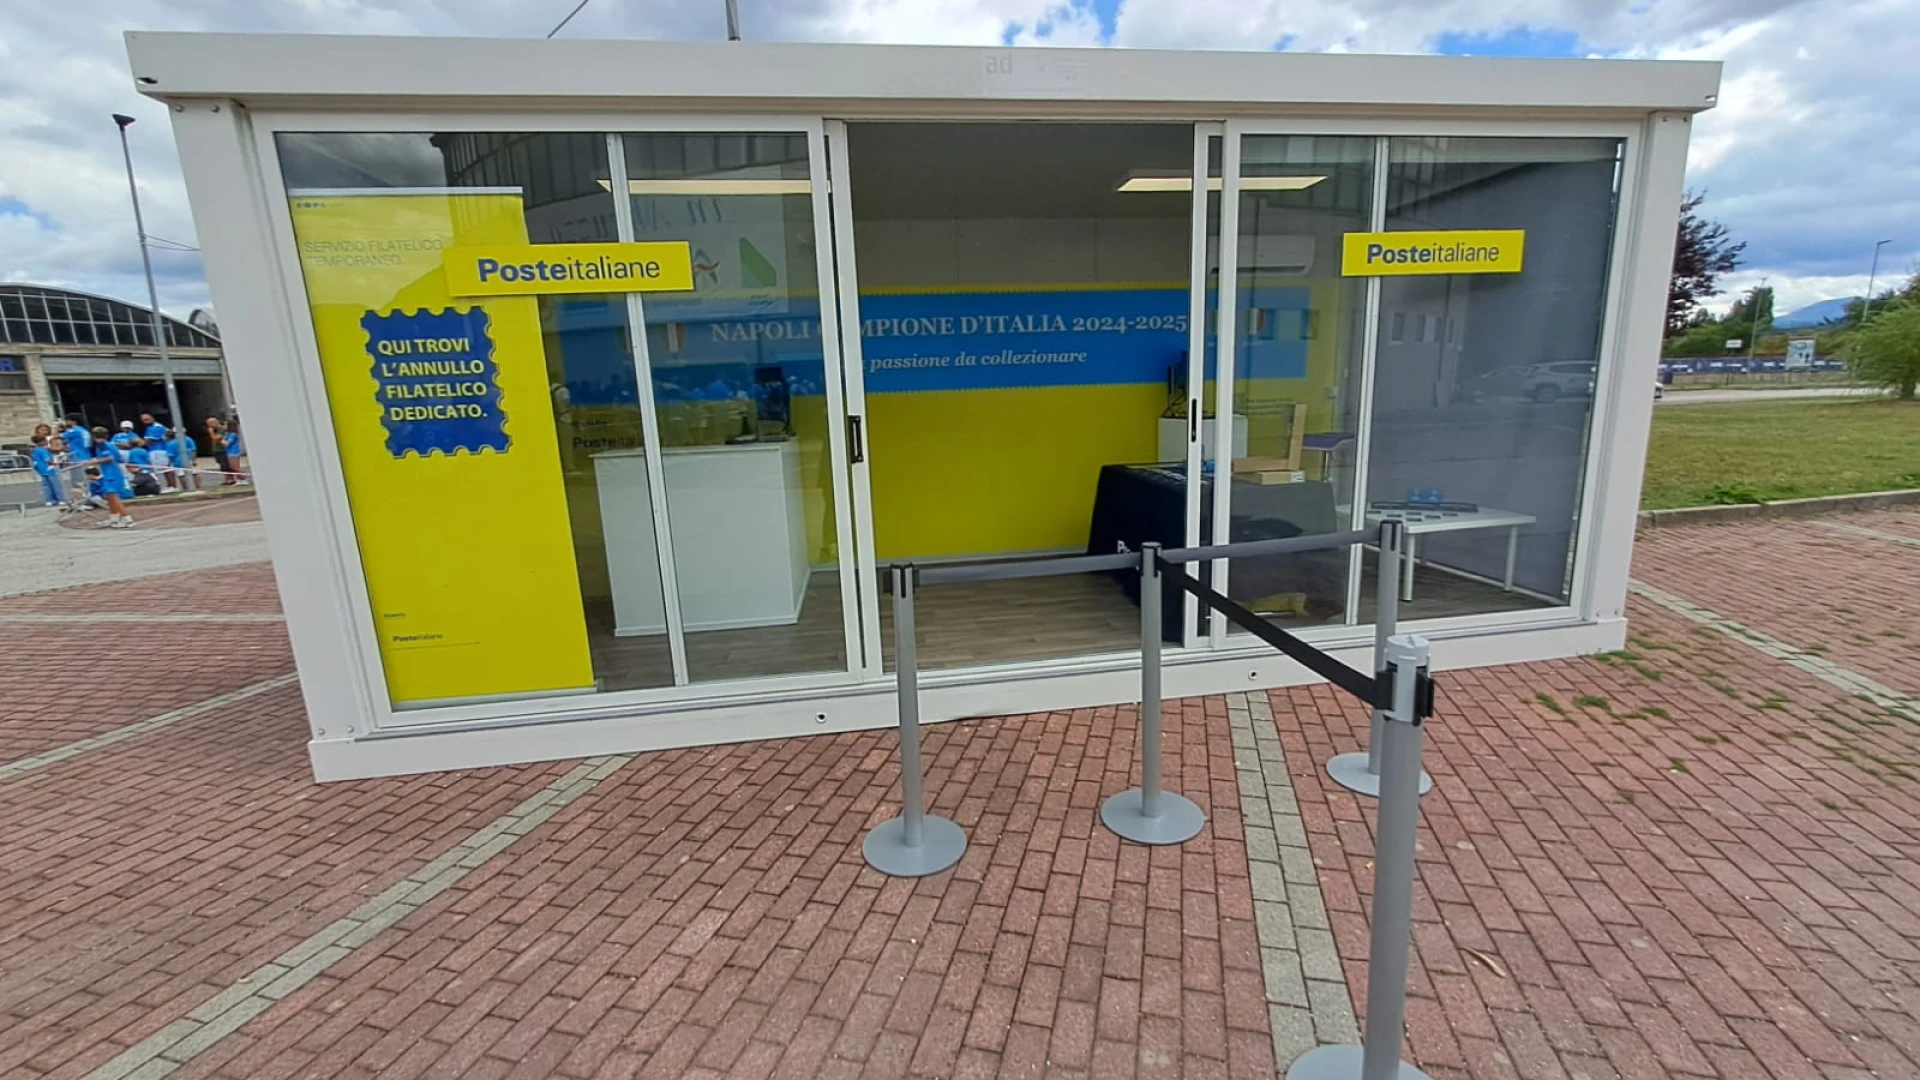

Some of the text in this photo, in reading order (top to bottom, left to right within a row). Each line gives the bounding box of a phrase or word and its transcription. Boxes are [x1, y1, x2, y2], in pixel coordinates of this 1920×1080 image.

[1366, 242, 1500, 264] Posteitaliane
[477, 256, 661, 282] Posteitaliane
[711, 320, 810, 342] NAPOLI
[817, 317, 955, 337] MPIONE
[1072, 315, 1187, 334] 2024-2025
[378, 337, 470, 356] QUI TROVI
[870, 354, 950, 372] passione
[954, 352, 977, 366] da
[981, 350, 1088, 365] collezionare
[386, 382, 487, 399] FILATELICO
[390, 404, 488, 421] DEDICATO.
